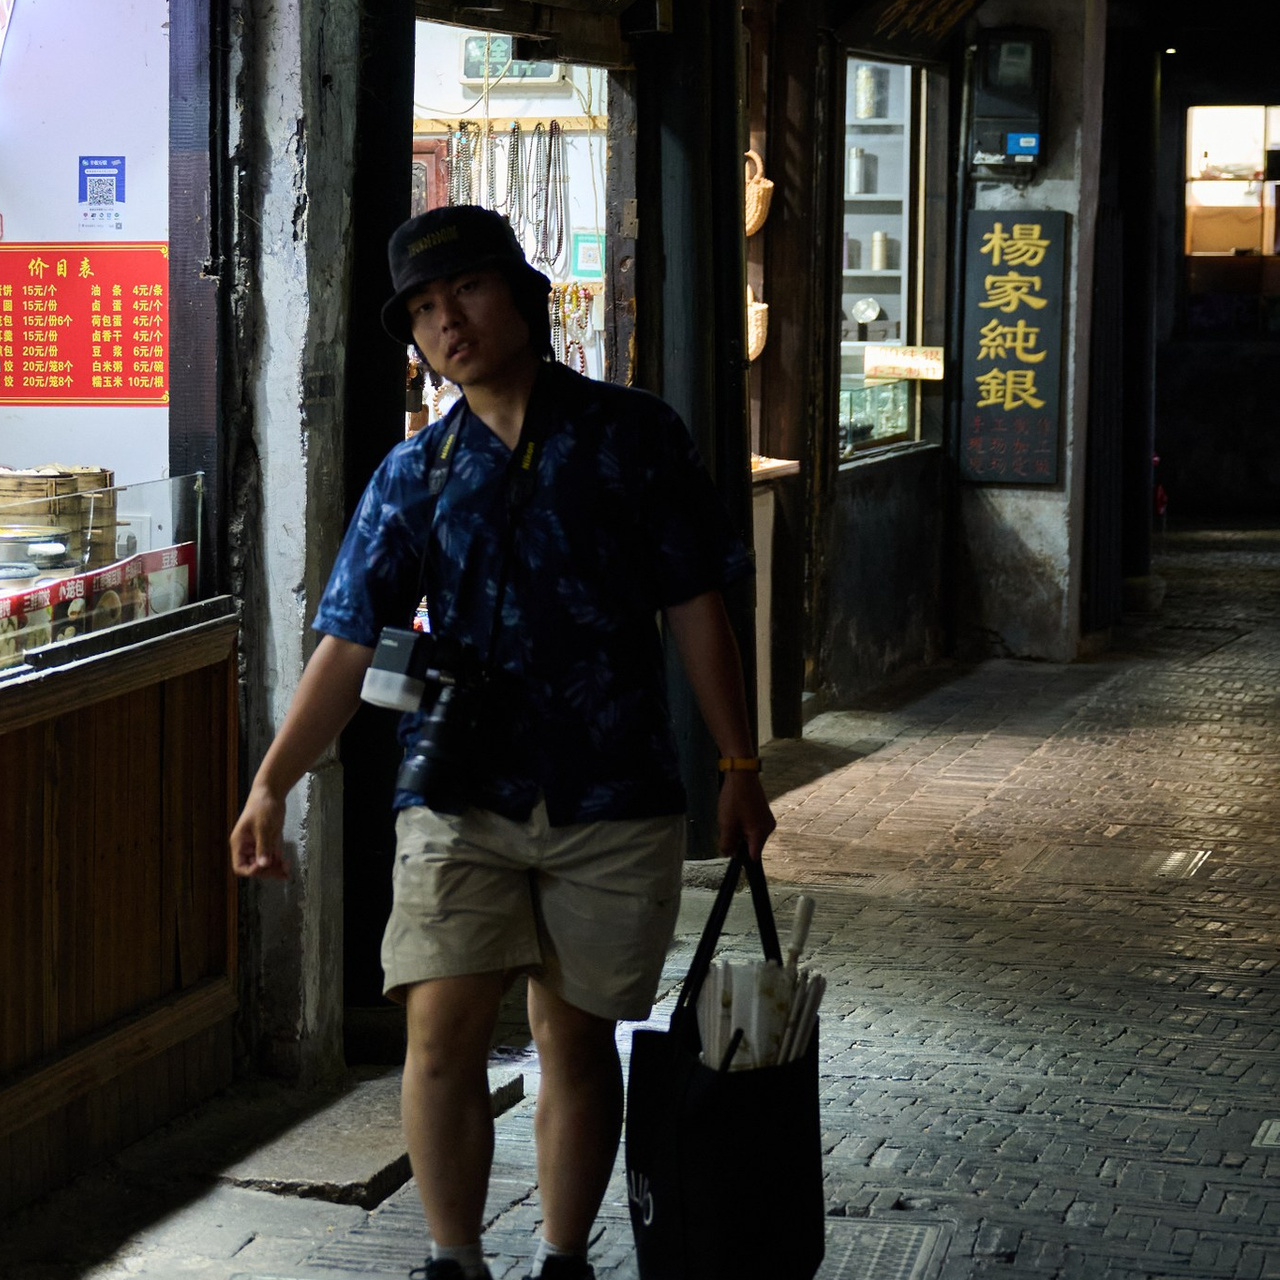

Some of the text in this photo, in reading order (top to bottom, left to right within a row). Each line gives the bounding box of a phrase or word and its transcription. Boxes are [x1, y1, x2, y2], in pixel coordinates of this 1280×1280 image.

[28, 256, 95, 279] 价目表
[22, 284, 57, 297] 15元/个
[91, 284, 163, 297] 油条 4元/条
[22, 299, 58, 312] 15元/份
[91, 299, 163, 312] 卤蛋 4元/个
[22, 314, 73, 327] 15元/份6个
[91, 314, 163, 327] 荷包蛋 4元/个
[976, 222, 1051, 412] 楊家純銀
[22, 329, 58, 342] 15元/份
[92, 329, 163, 342] 卤香干 4元/个
[22, 345, 58, 357] 20元/份
[92, 345, 164, 357] 豆浆 6元/份
[22, 360, 74, 373] 20元/笼8个
[92, 360, 164, 373] 白米粥 6元/碗
[22, 375, 74, 388] 20元/笼8个
[91, 375, 164, 388] 糯玉米 10元/根
[521, 441, 535, 470] Nikon
[162, 549, 179, 569] 豆浆
[58, 580, 85, 601] 小笼包
